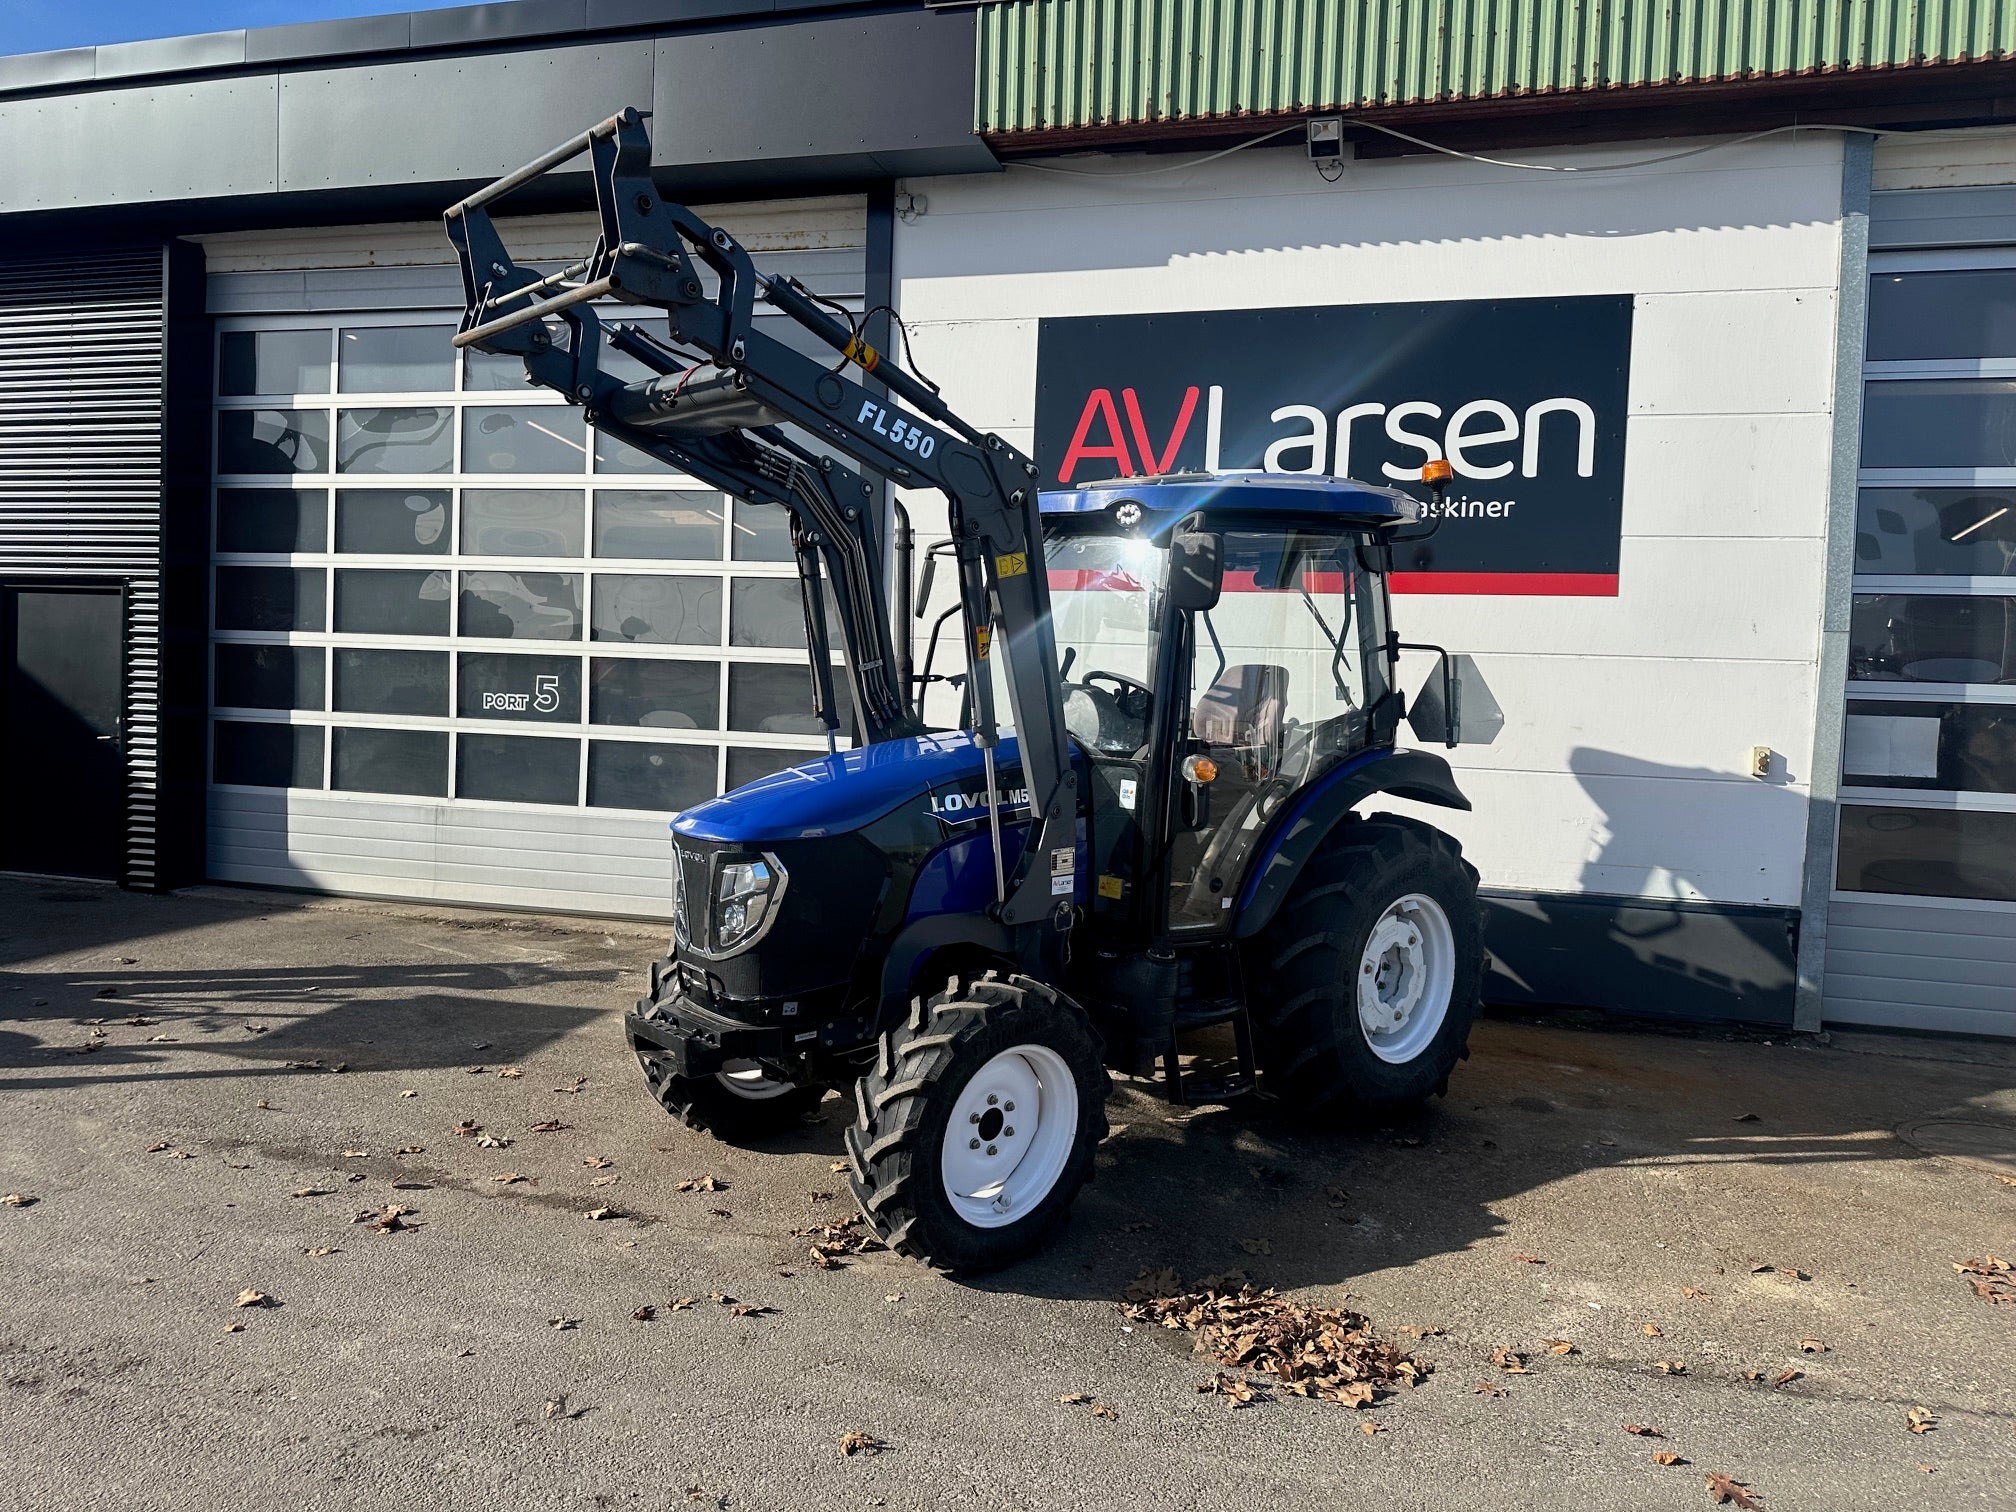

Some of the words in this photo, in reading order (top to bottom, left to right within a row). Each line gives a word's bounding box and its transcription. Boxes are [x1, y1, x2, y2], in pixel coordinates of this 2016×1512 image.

[857, 400, 935, 459] FL550
[1057, 385, 1595, 483] AVLarsen
[1420, 496, 1516, 518] askiner
[483, 692, 529, 710] PORT
[533, 674, 560, 713] 5
[931, 789, 1008, 812] LOVOL
